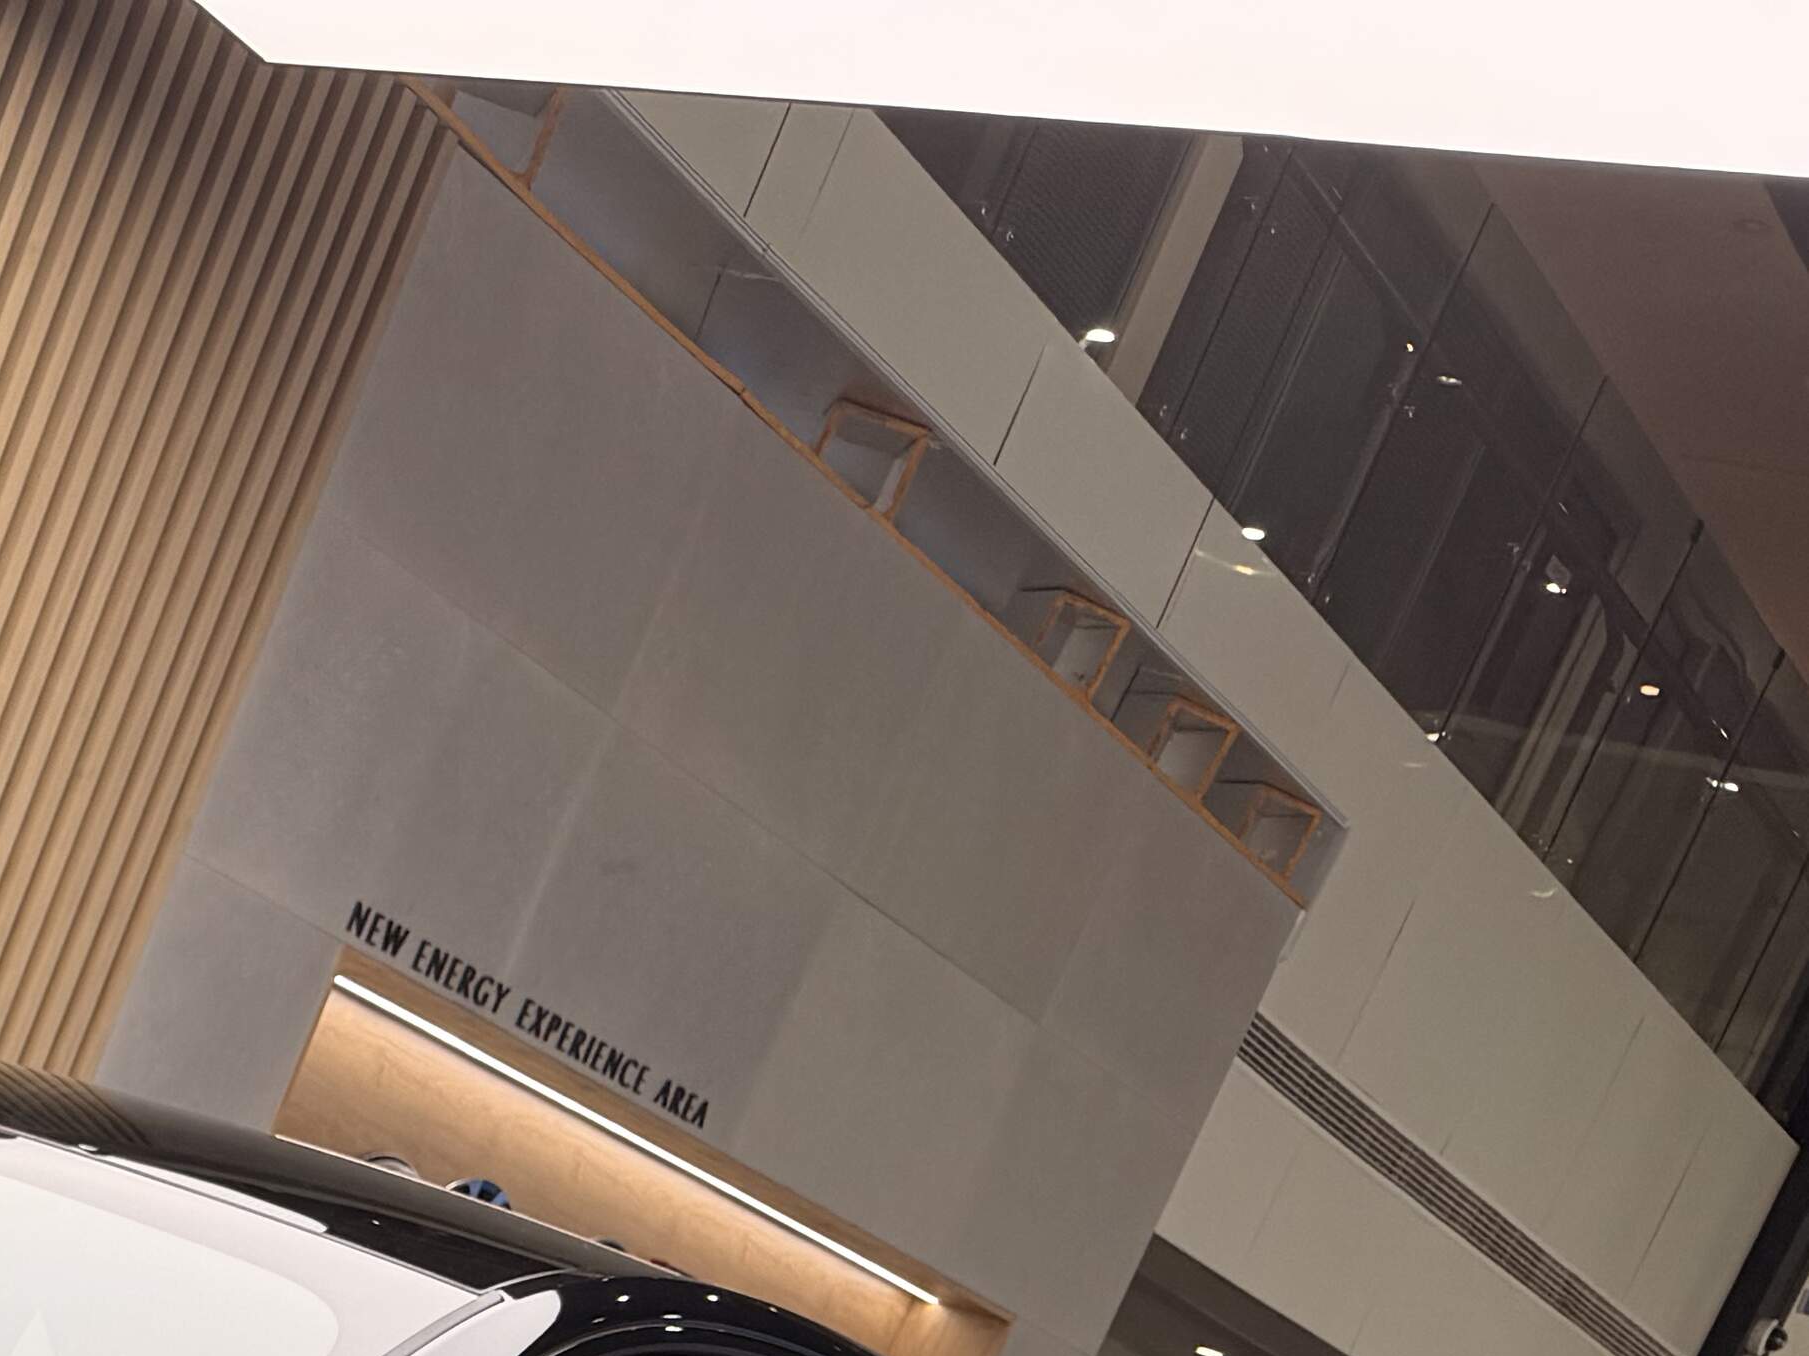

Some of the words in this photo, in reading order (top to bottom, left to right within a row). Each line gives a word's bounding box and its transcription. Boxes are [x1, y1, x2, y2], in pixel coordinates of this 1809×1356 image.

[346, 901, 411, 957] NEW
[411, 940, 511, 1014] ENERGY
[515, 999, 651, 1094] EXPERIENCE
[653, 1080, 711, 1129] AREA
